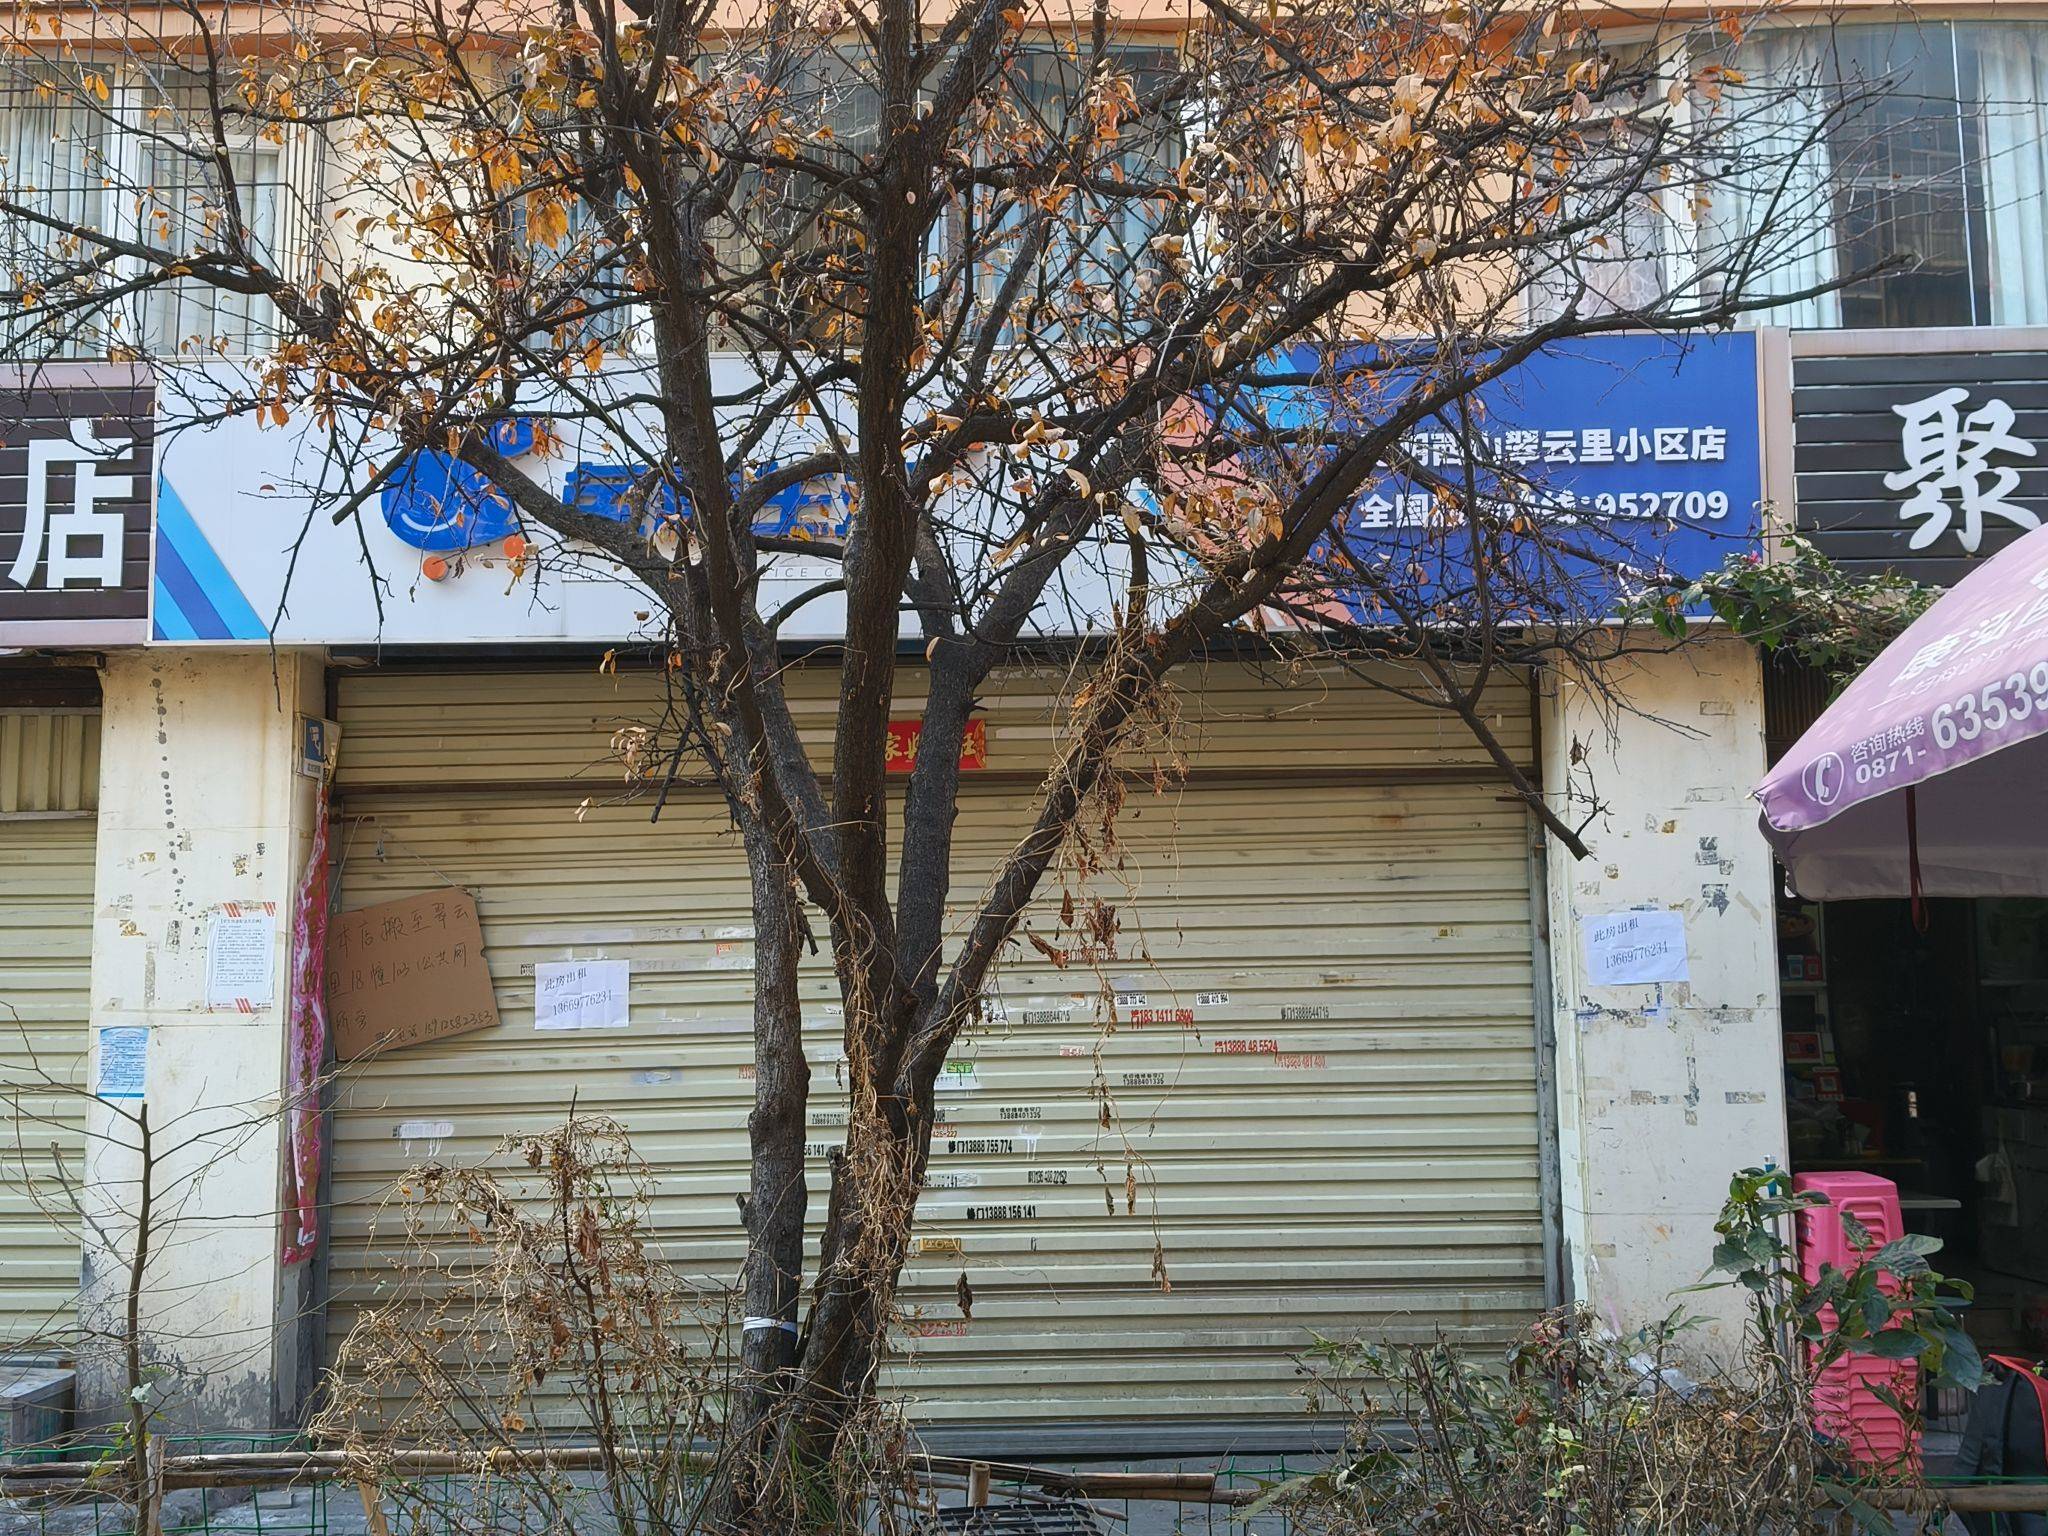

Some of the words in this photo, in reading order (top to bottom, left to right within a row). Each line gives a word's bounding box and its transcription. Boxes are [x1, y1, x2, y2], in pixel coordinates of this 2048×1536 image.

[8, 418, 133, 588] 店
[1883, 387, 2043, 553] 聚
[1850, 715, 1926, 764] 咨询热线
[1855, 746, 1927, 785] 0871-
[1931, 661, 2048, 750] 63539
[1594, 917, 1639, 942] 此房出租
[544, 967, 587, 992] 此房出租
